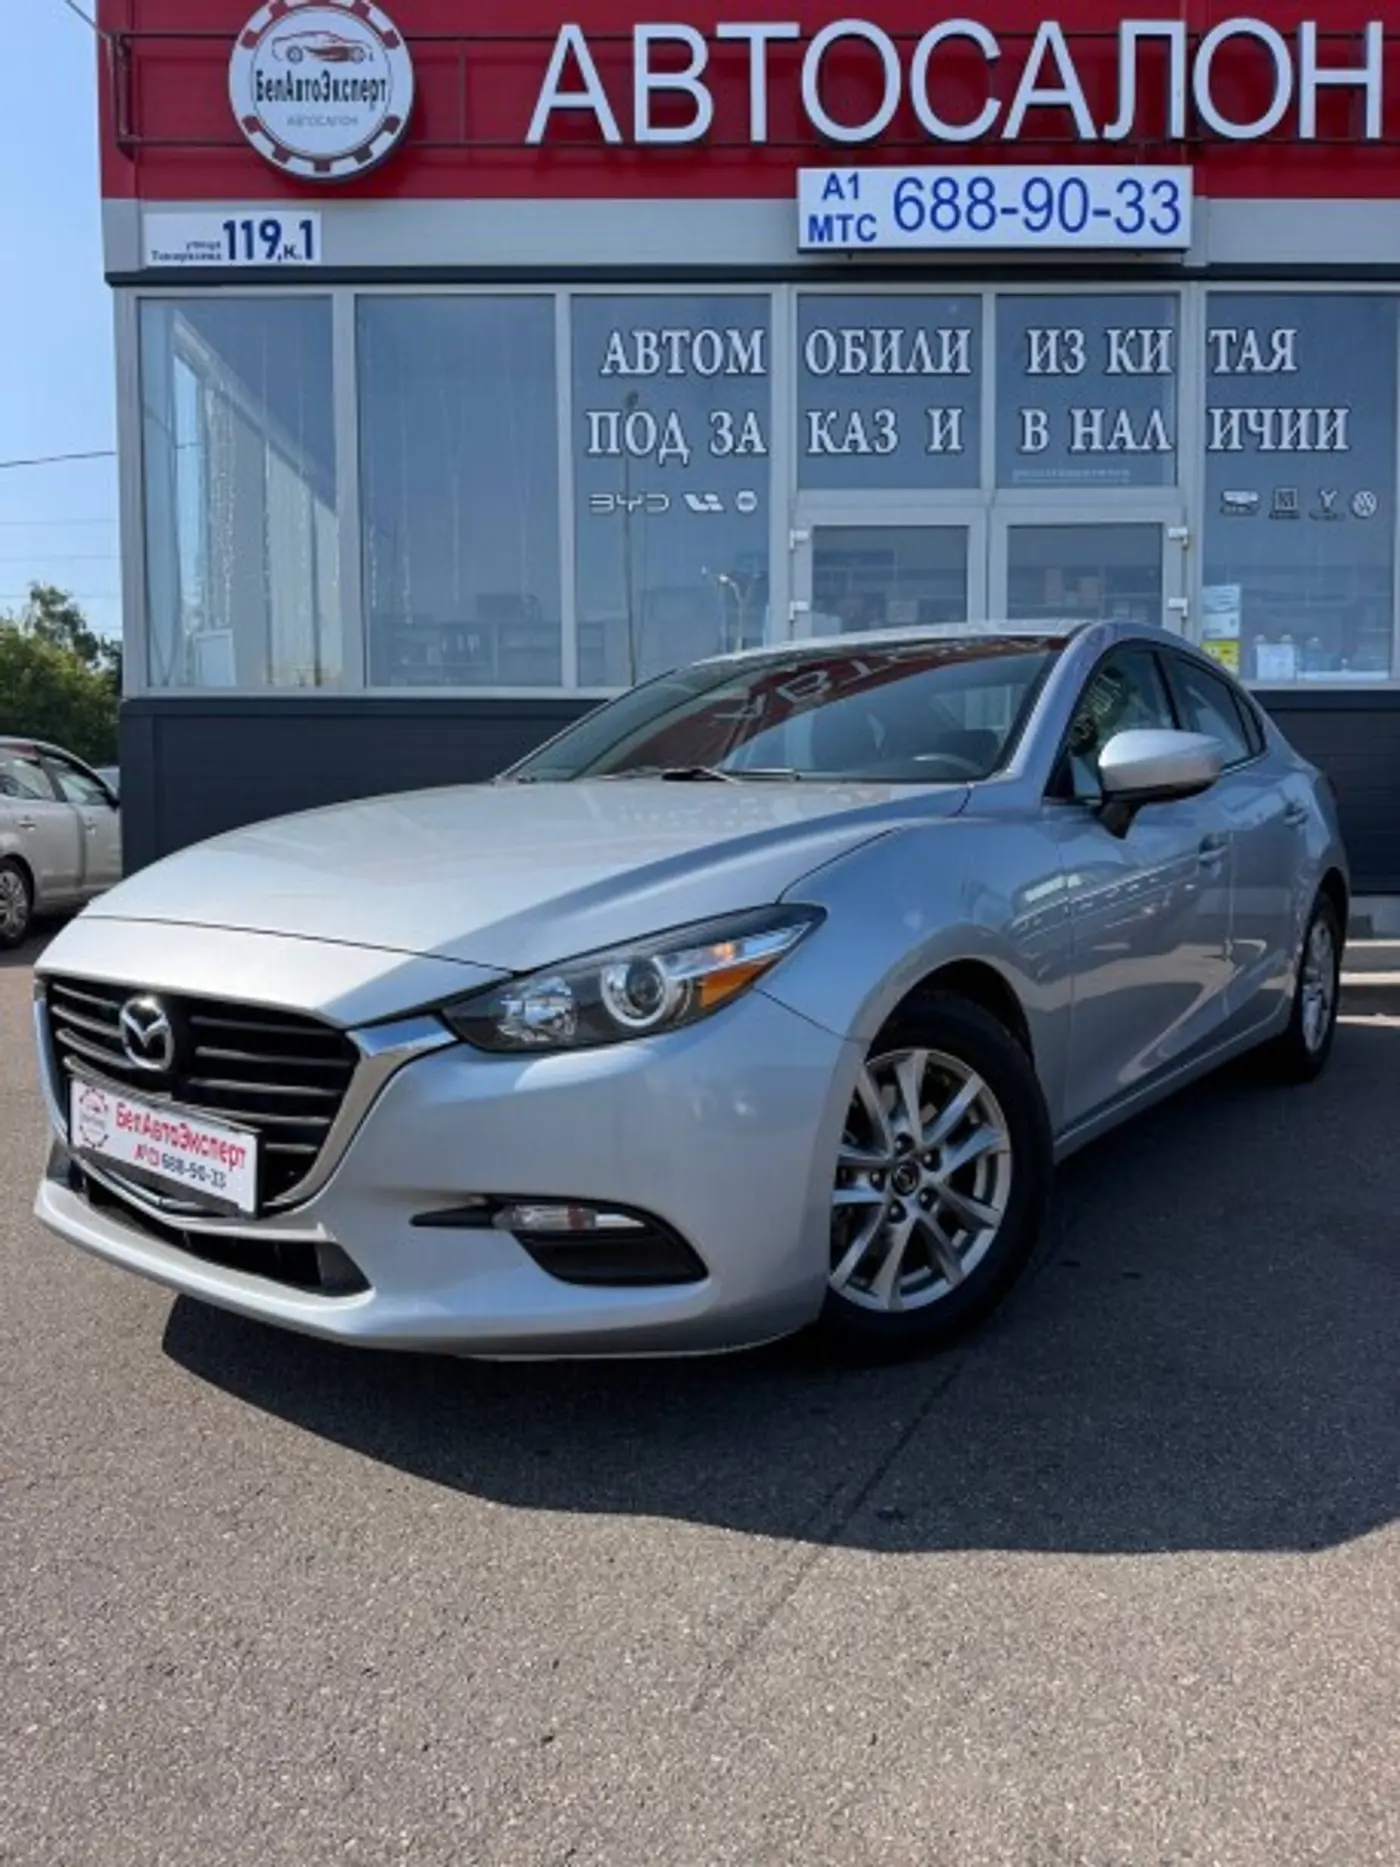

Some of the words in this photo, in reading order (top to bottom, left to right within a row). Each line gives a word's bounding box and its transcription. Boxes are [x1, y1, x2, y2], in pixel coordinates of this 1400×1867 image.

[255, 69, 387, 112] БелАвтоЭксперт
[525, 18, 1383, 144] АВТОСАЛОН
[822, 172, 860, 201] A1
[892, 176, 1182, 235] 688-90-33
[807, 213, 878, 243] МТС
[1026, 329, 1086, 373] ИЗ
[587, 410, 691, 465] ПОД
[927, 409, 963, 453] И
[1020, 409, 1050, 453] В
[116, 1101, 247, 1173] БелАвтоЭксперт
